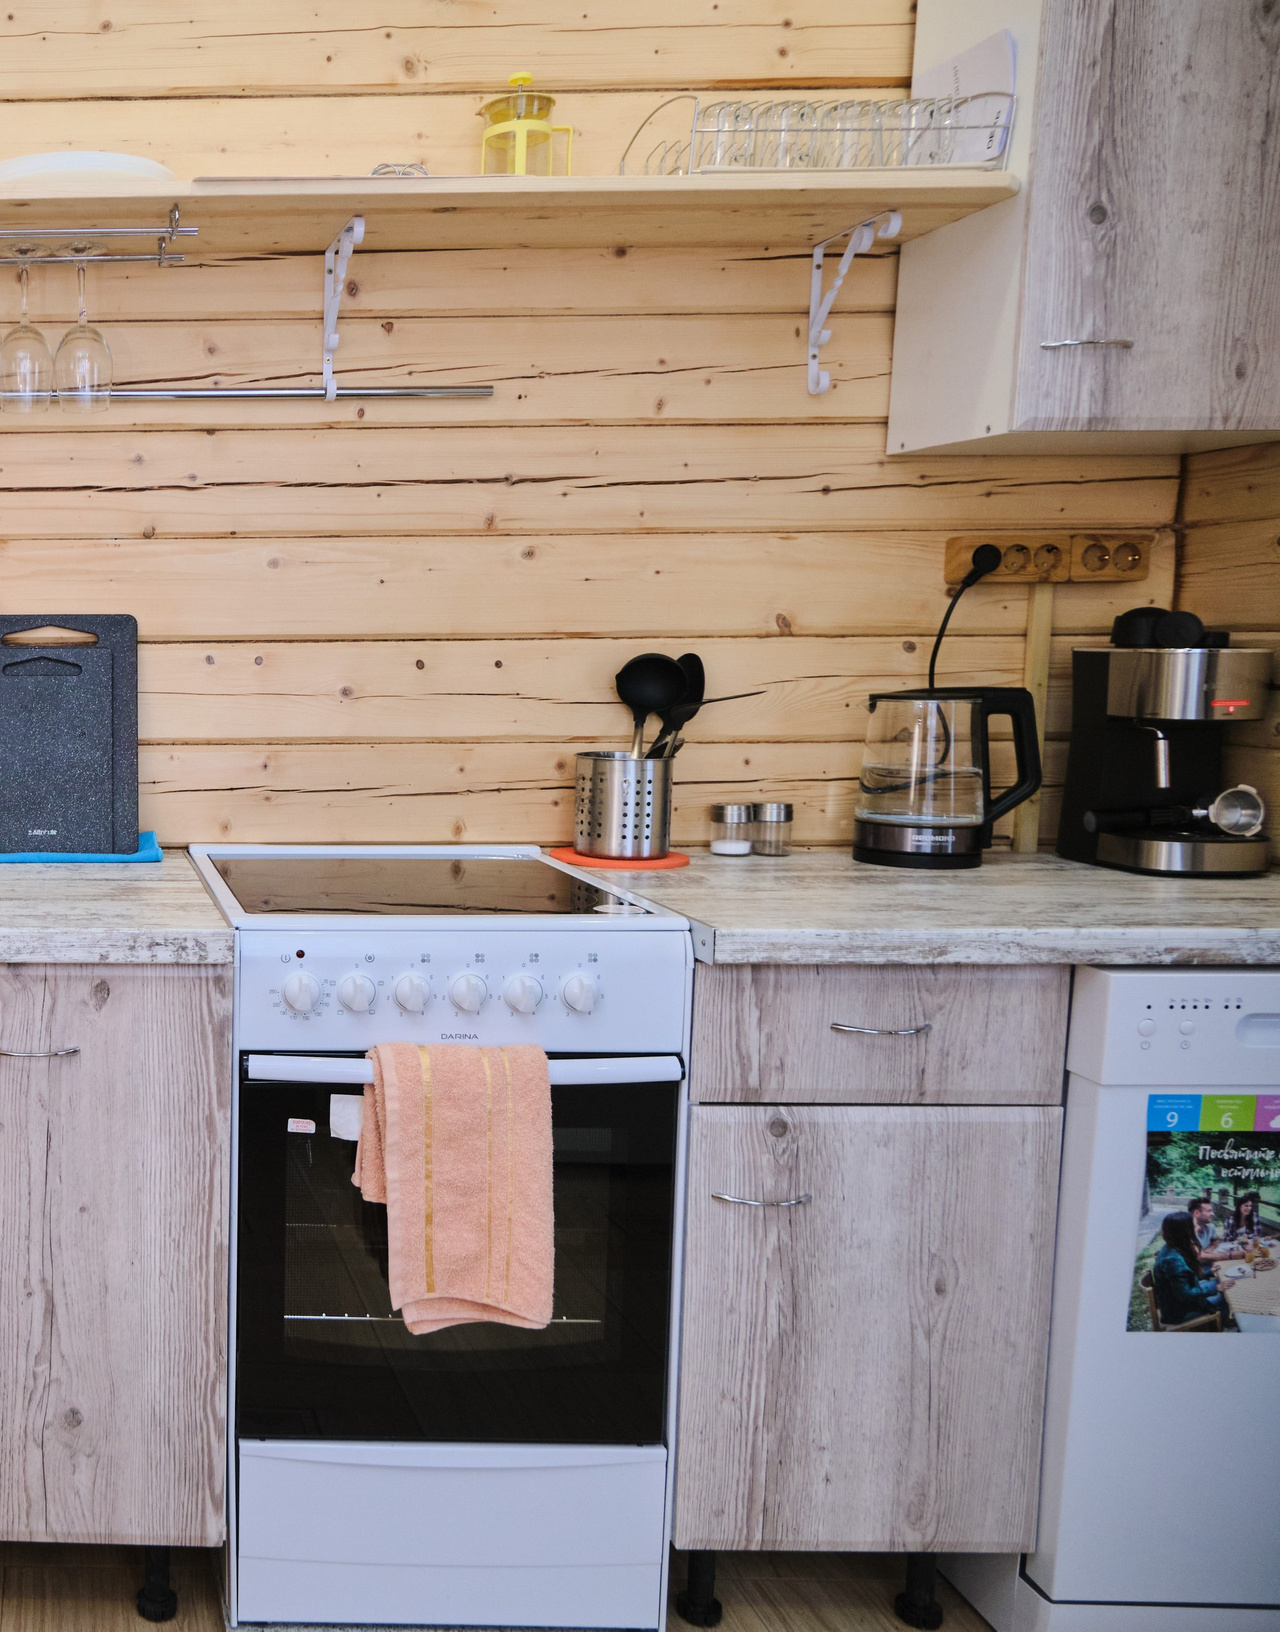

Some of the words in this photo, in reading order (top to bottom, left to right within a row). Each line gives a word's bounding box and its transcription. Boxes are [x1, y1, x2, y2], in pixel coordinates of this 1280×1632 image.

[1166, 1111, 1179, 1128] 9
[1220, 1112, 1233, 1129] 6
[1198, 1138, 1275, 1161] Посвятите
